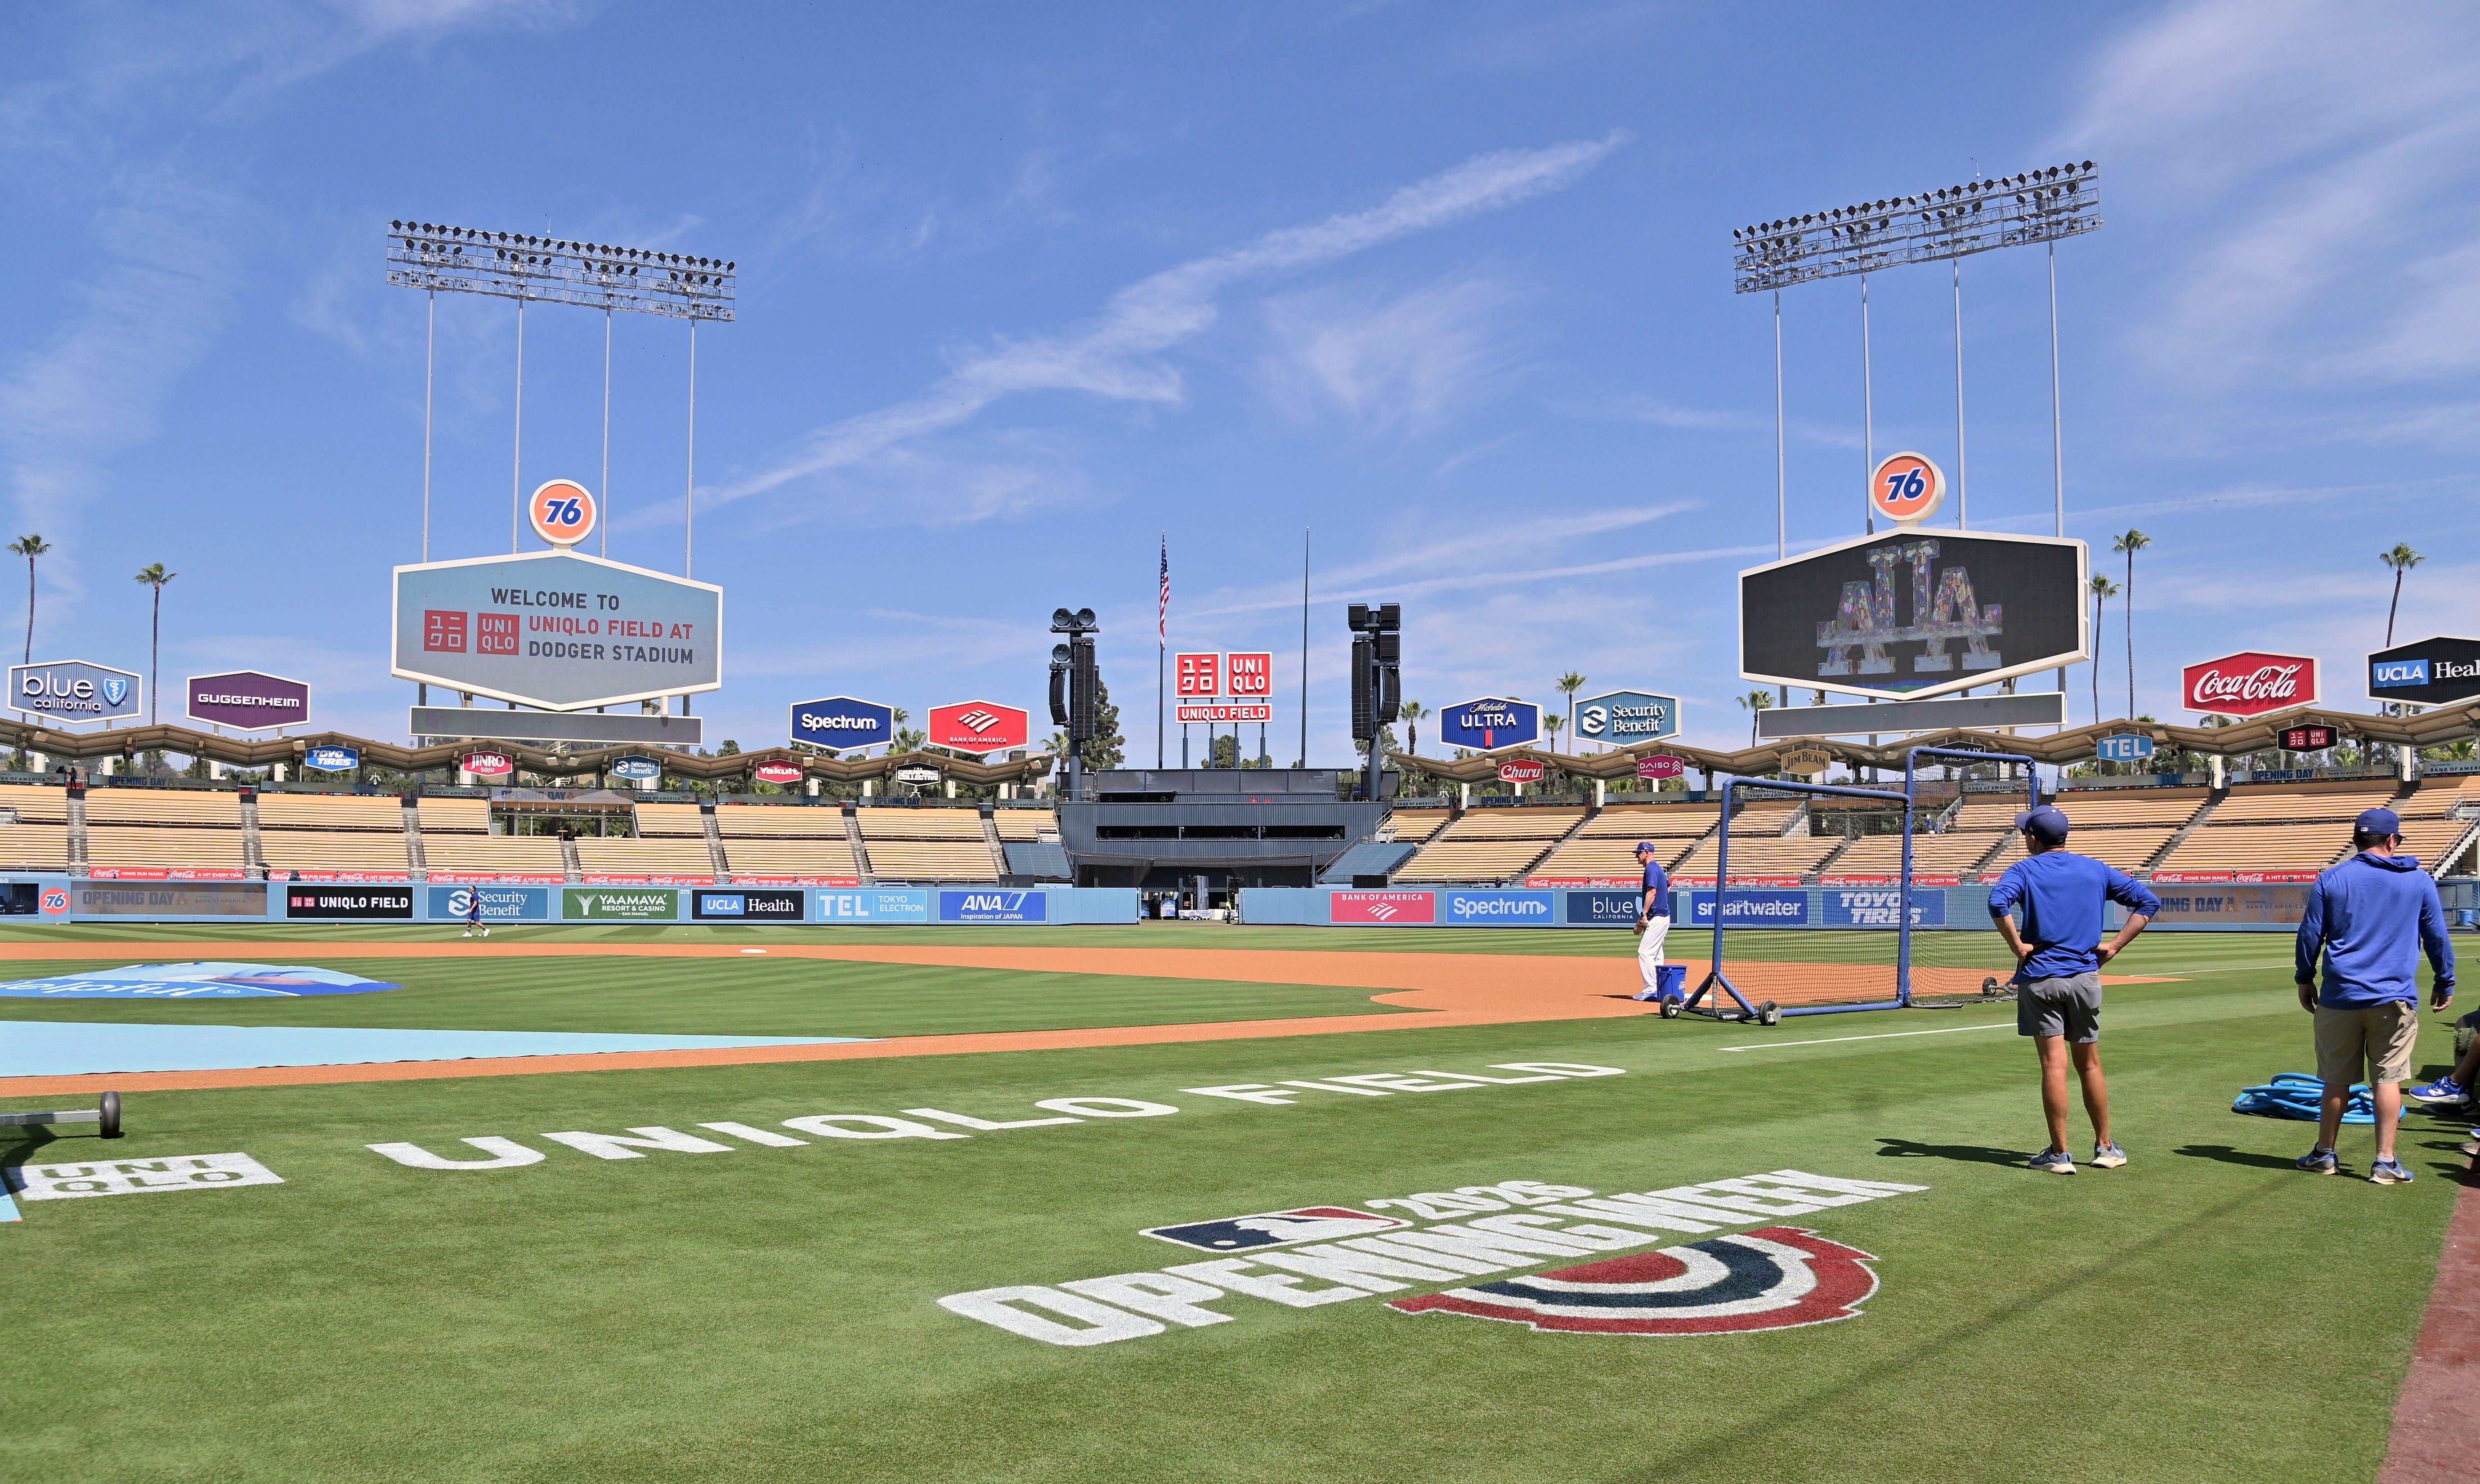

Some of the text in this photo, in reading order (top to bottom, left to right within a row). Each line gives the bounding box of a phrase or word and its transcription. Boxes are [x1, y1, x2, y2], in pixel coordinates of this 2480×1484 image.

[1884, 466, 1927, 503] 76
[543, 496, 584, 527] 76
[491, 588, 620, 610] WELCOME TO
[430, 616, 461, 630] ユニ
[482, 618, 512, 633] UNI
[528, 616, 693, 639] UNIQLO FIELD AT
[429, 633, 461, 648] クロ
[482, 635, 515, 650] QLO
[529, 641, 693, 664] DODGER STADIUM
[1183, 659, 1212, 673] ユニ
[1233, 659, 1262, 673] UNI
[2377, 660, 2480, 682] UCLA Heal
[23, 670, 93, 698] blue
[1182, 676, 1212, 690] クロ
[1233, 676, 1265, 693] QLO
[2193, 663, 2303, 703] Coca-Cola
[33, 698, 101, 711] california
[198, 693, 300, 707] GUGGENHEIM
[1469, 702, 1507, 713] Michelob
[1182, 707, 1266, 721] UNIQLO FIELD
[1612, 703, 1667, 719] Security
[801, 713, 876, 732] Spectrum
[1461, 714, 1517, 727] ULTRA
[1613, 719, 1660, 733] Benefit
[313, 750, 344, 758] TOYO
[2103, 738, 2146, 757] TEL
[471, 755, 505, 768] JINRO
[631, 761, 655, 769] Security
[1785, 751, 1826, 770] JIM BEAM
[759, 767, 800, 776] Yakult
[1500, 765, 1541, 778] Churu
[2252, 770, 2292, 780] OPENING
[2296, 769, 2314, 778] DAY
[109, 776, 167, 786] OPENING DAY
[501, 791, 566, 800] OPENING DAY
[1481, 796, 1511, 805] OPENING
[94, 869, 120, 877] Coca-Cola
[170, 870, 196, 878] Coca-Cola
[2156, 874, 2182, 882] Coca-Cola
[2236, 873, 2264, 882] Coca-Cola
[44, 893, 66, 908] 76
[83, 891, 175, 906] OPENING DAY
[320, 897, 408, 910] UNIQLO FIELD
[478, 891, 528, 905] Security
[707, 898, 794, 912] UCLA Health
[820, 895, 868, 916] TEL
[961, 895, 1002, 911] ANA
[1593, 897, 1634, 913] blue
[2195, 897, 2223, 912] DAY
[479, 905, 521, 916] Benefit
[1453, 897, 1541, 919] Spectrum
[0, 981, 219, 997] elpful
[367, 1062, 1627, 1172] UNIQLO FIELD
[42, 1159, 210, 1179] UNI
[53, 1171, 243, 1193] QLO
[1366, 1181, 1594, 1222] 2026
[938, 1167, 1931, 1347] OPENING WEEK
